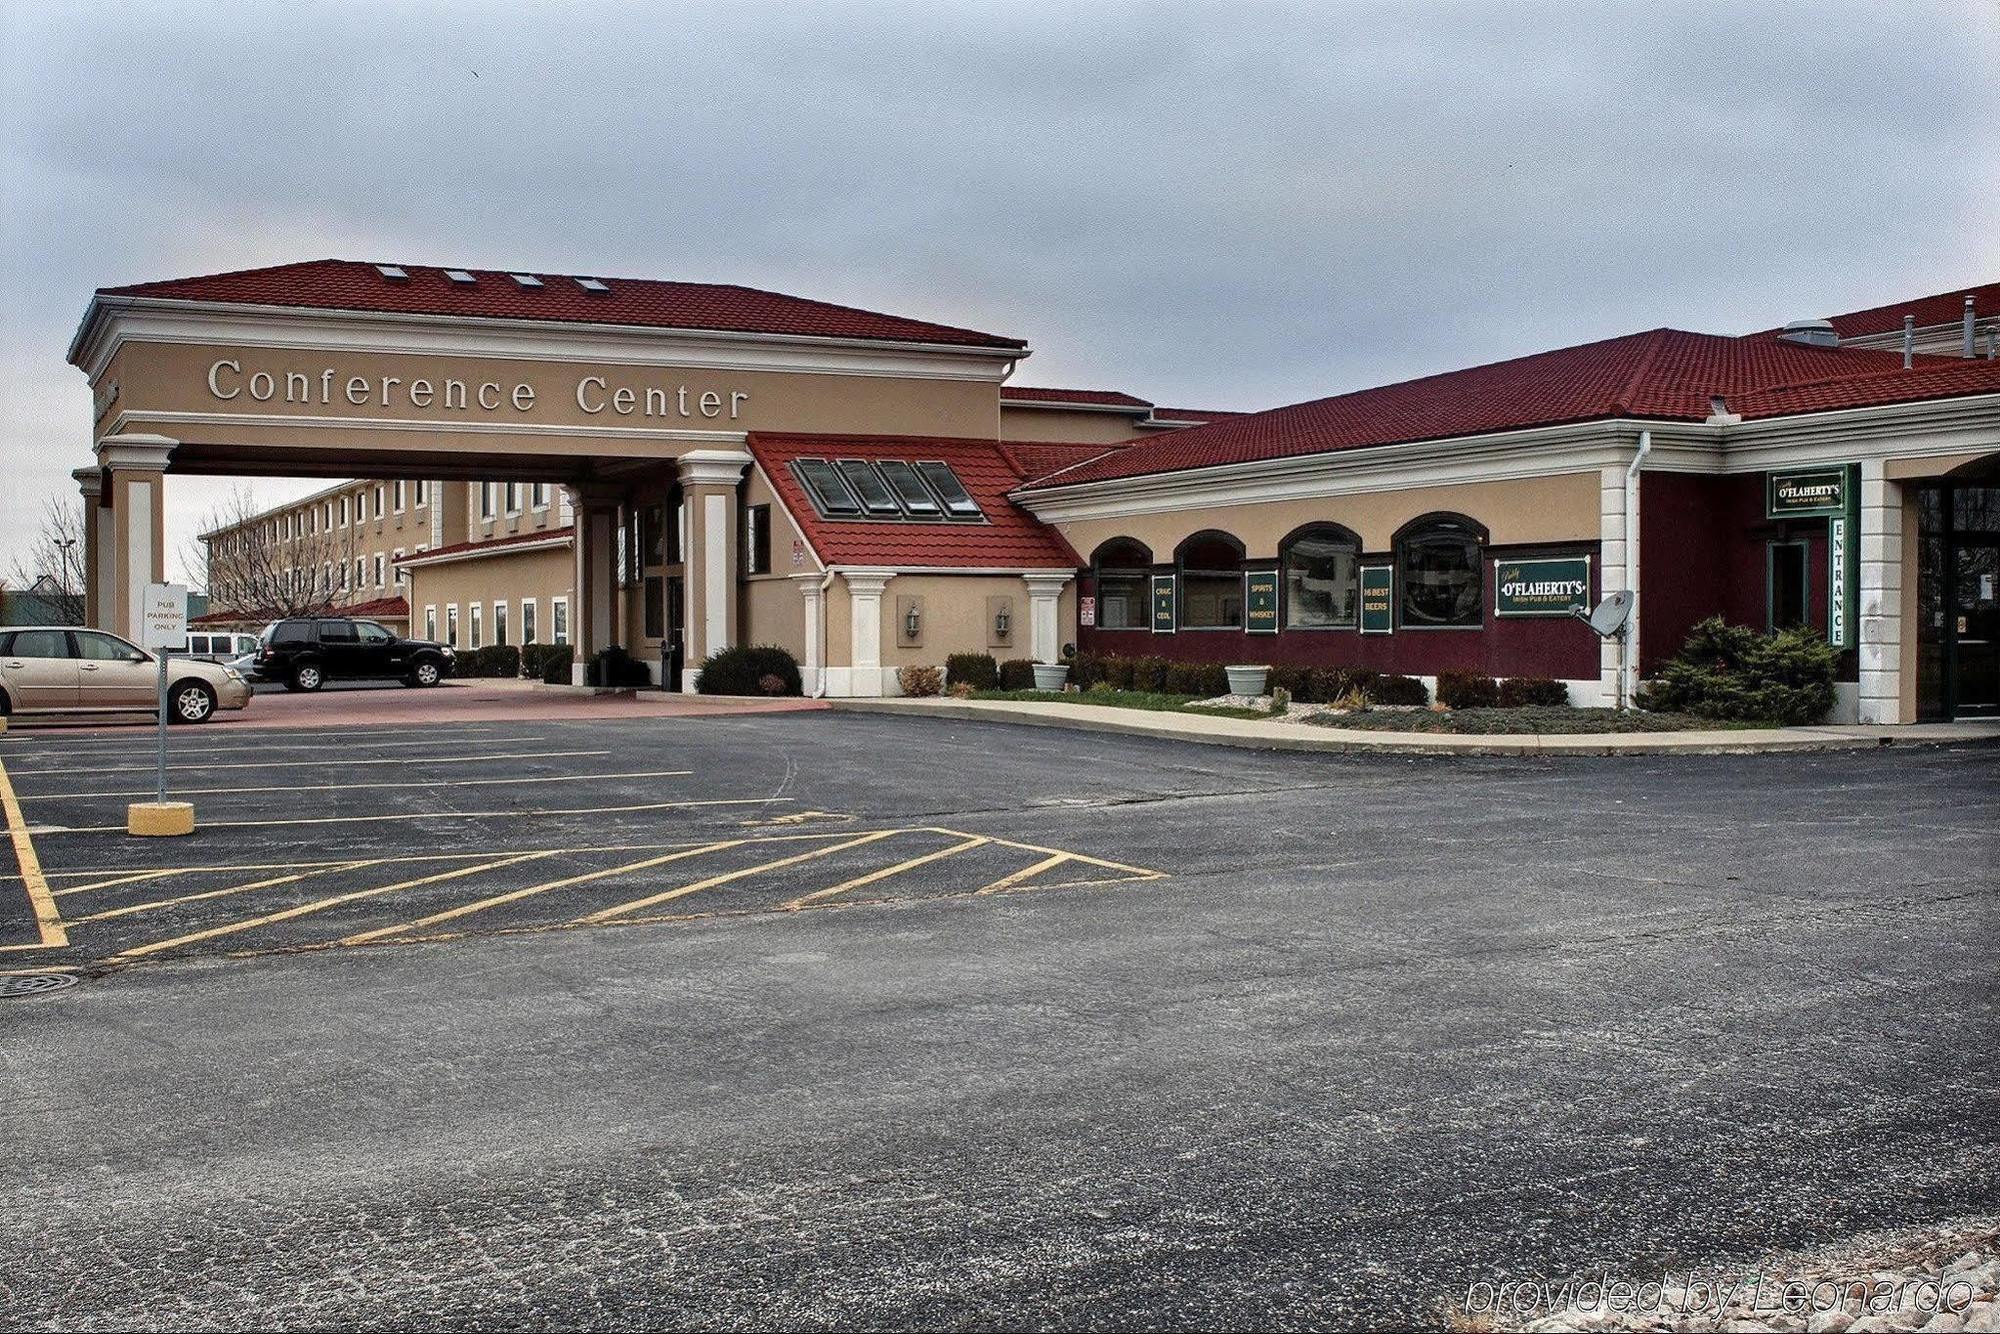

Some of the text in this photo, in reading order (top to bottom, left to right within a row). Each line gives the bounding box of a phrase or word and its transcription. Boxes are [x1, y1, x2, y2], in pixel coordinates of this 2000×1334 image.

[207, 359, 750, 419] Conference Center
[1778, 483, 1840, 498] O'FLAHERTY'S
[1834, 523, 1843, 642] ENTRANCE
[1372, 588, 1389, 597] BEST
[1503, 580, 1583, 597] O'FLAHERTY'S
[1529, 595, 1542, 603] PUB
[157, 601, 175, 609] PUB
[1364, 602, 1388, 611] BEERS
[147, 612, 184, 620] PARKING
[154, 623, 177, 631] ONLY
